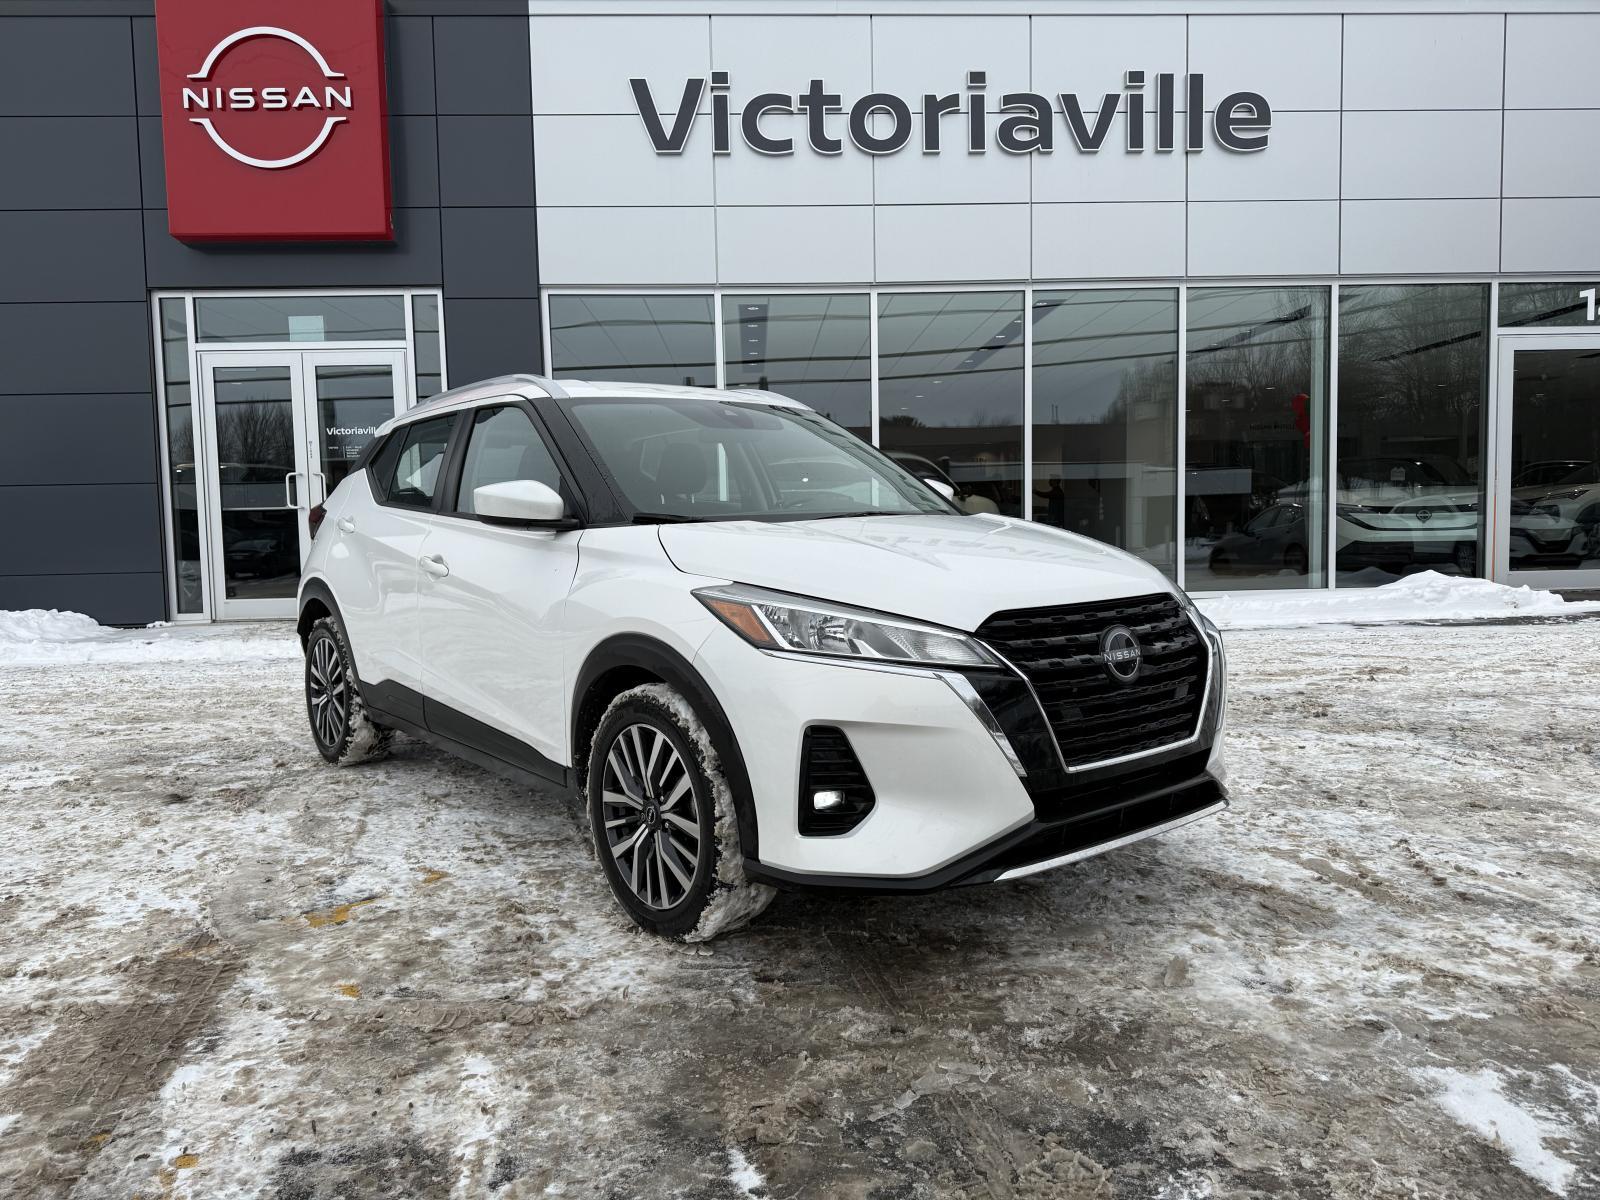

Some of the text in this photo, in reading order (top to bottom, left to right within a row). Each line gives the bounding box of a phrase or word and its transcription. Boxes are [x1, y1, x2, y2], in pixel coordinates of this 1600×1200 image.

[181, 86, 353, 110] NISSAN
[628, 70, 1274, 156] Victoriaville
[1579, 288, 1600, 321] 1
[326, 426, 377, 436] Victoriavill
[1104, 649, 1141, 662] NISSAN
